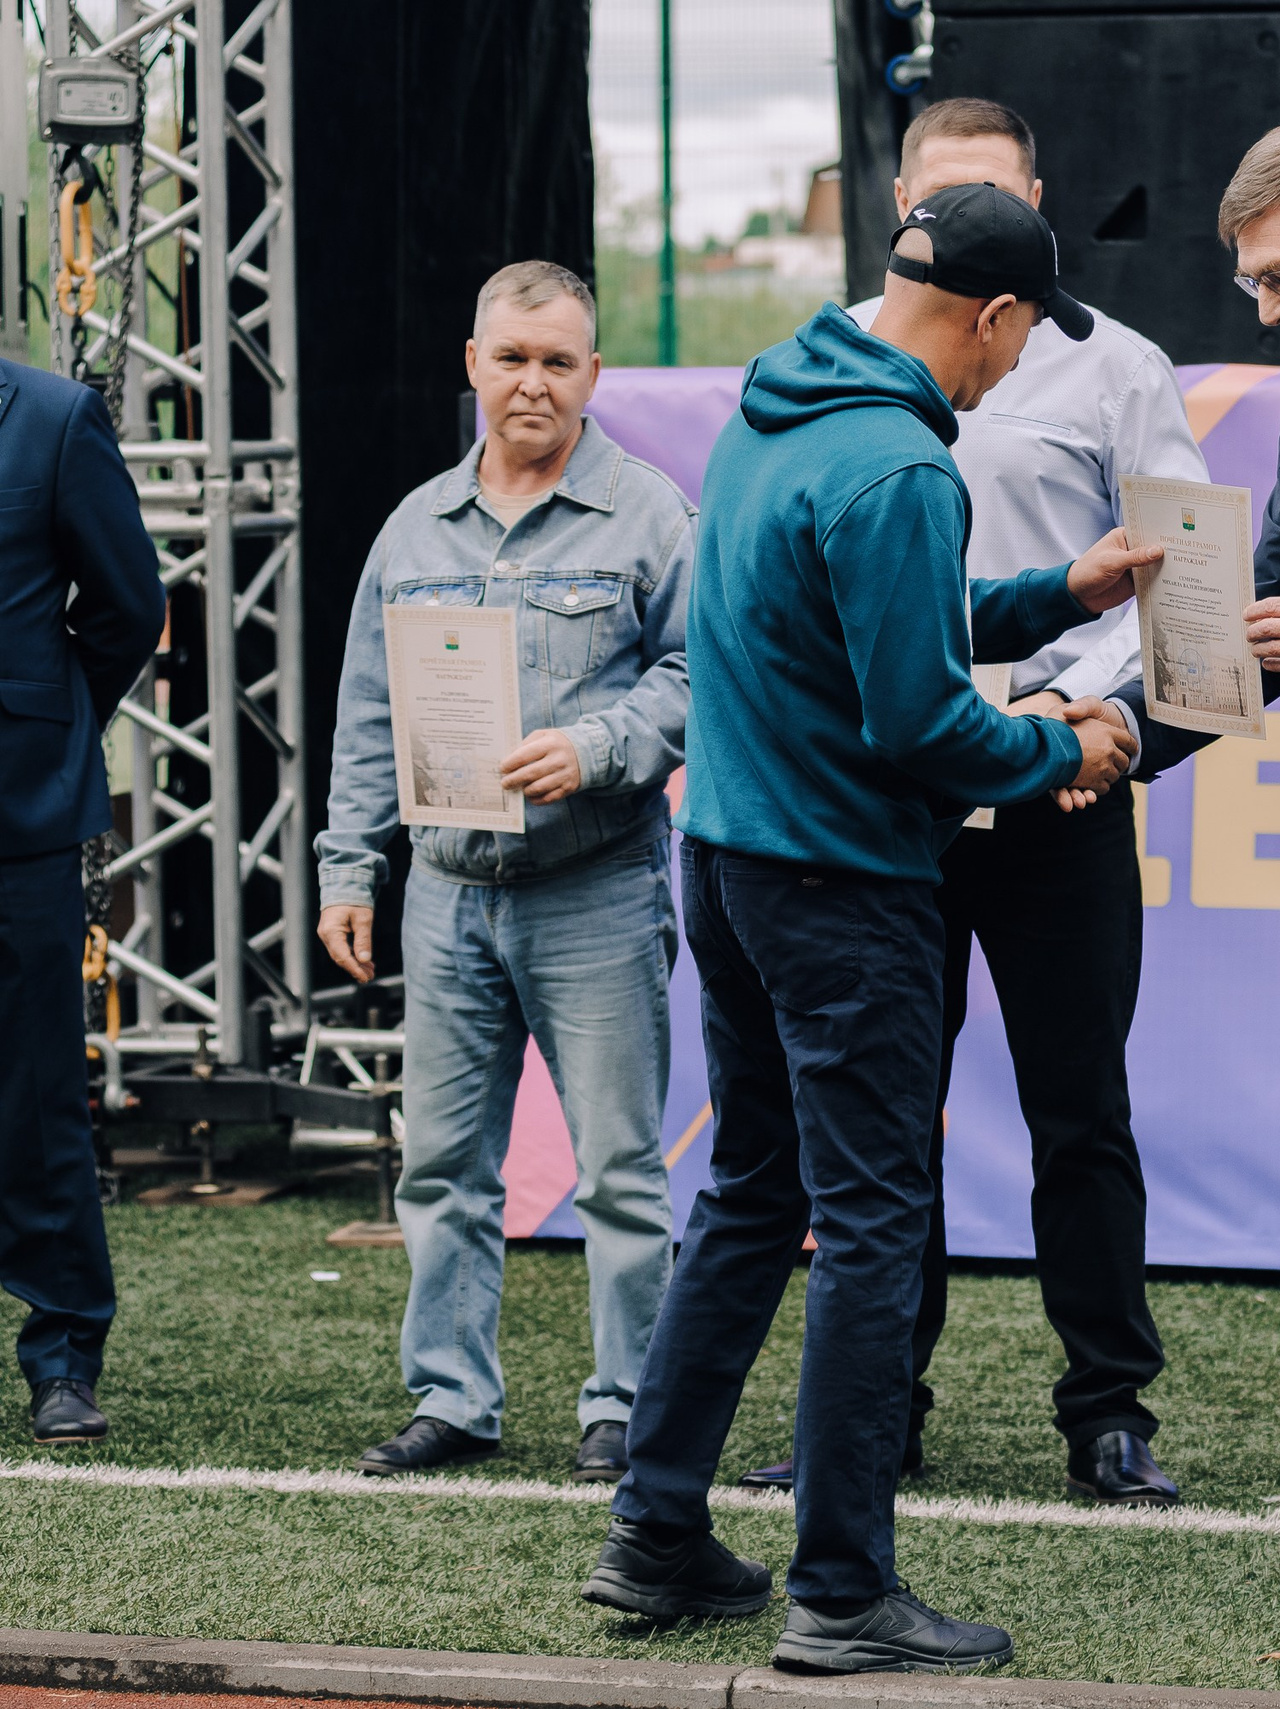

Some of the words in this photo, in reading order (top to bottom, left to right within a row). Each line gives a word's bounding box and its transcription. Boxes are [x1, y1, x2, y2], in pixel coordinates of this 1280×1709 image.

[1160, 535, 1192, 547] ПОЧЁТНАЯ
[1192, 541, 1221, 552] ГРАМОТА
[1173, 555, 1208, 566] НАГРАЖДАЕТ
